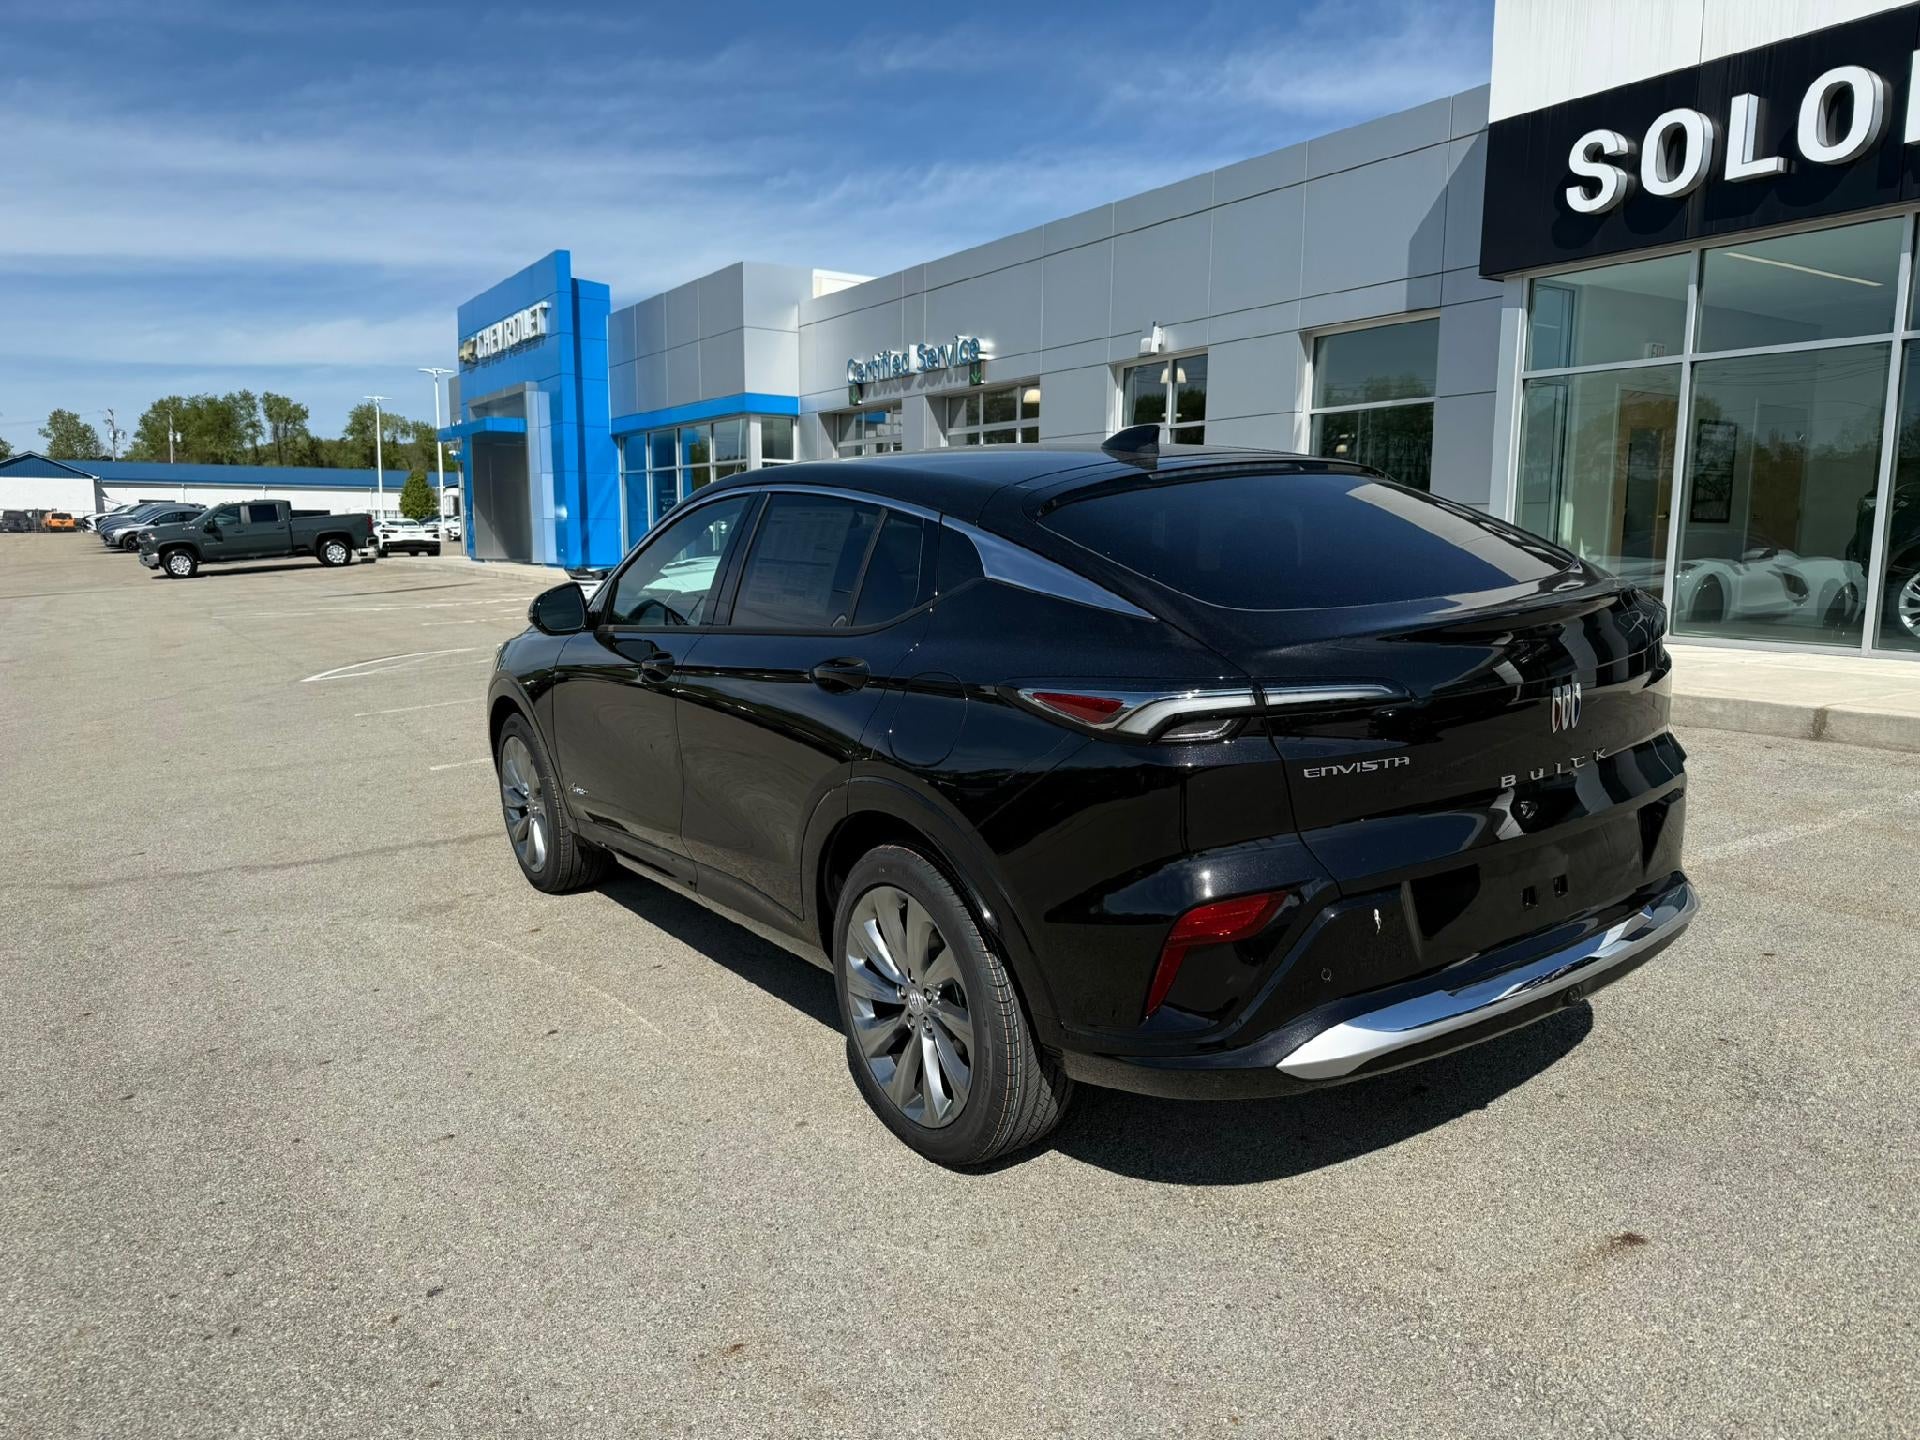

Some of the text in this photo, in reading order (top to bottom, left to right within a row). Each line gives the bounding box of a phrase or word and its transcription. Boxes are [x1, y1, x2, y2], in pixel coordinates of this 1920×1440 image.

[1566, 51, 1920, 214] SOLO
[477, 301, 551, 358] CHEVROLET
[847, 336, 981, 384] Certified Service
[1303, 756, 1410, 778] ENVISTA
[1501, 748, 1606, 789] BUICK
